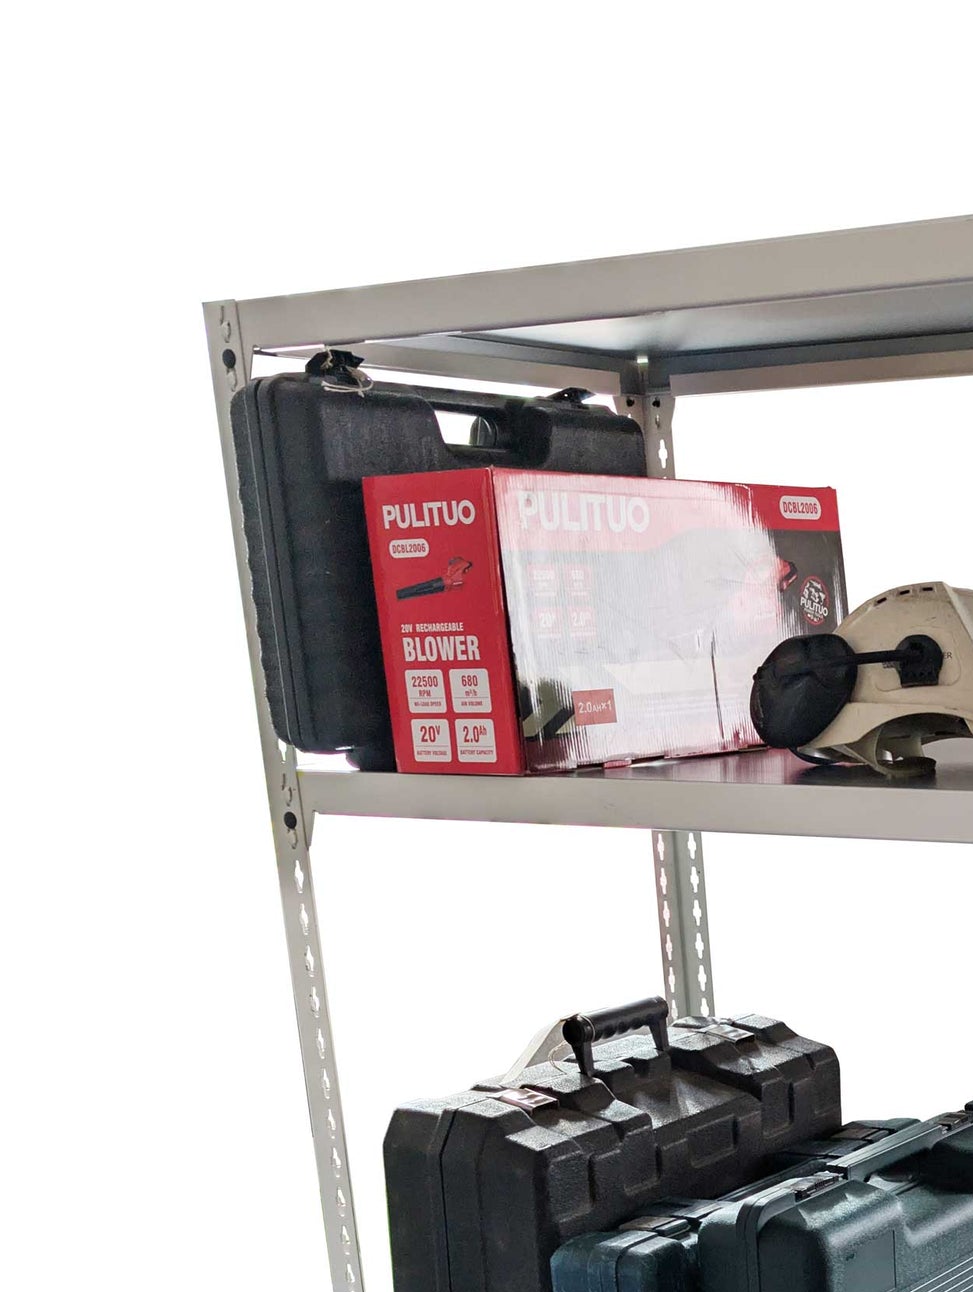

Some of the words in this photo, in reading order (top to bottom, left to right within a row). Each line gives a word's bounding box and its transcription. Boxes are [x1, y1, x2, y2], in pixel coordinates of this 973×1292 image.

[518, 491, 650, 533] PULITUO
[782, 501, 818, 514] DCBL2006
[382, 500, 475, 529] PULITUO
[391, 543, 426, 554] DCBL2006
[800, 597, 828, 617] PULITUO
[401, 624, 413, 633] 20V
[415, 622, 464, 632] RECHARGEABLE
[402, 635, 481, 662] BLOWER
[411, 675, 438, 687] 22500
[461, 675, 478, 686] 680
[418, 689, 431, 697] RPM
